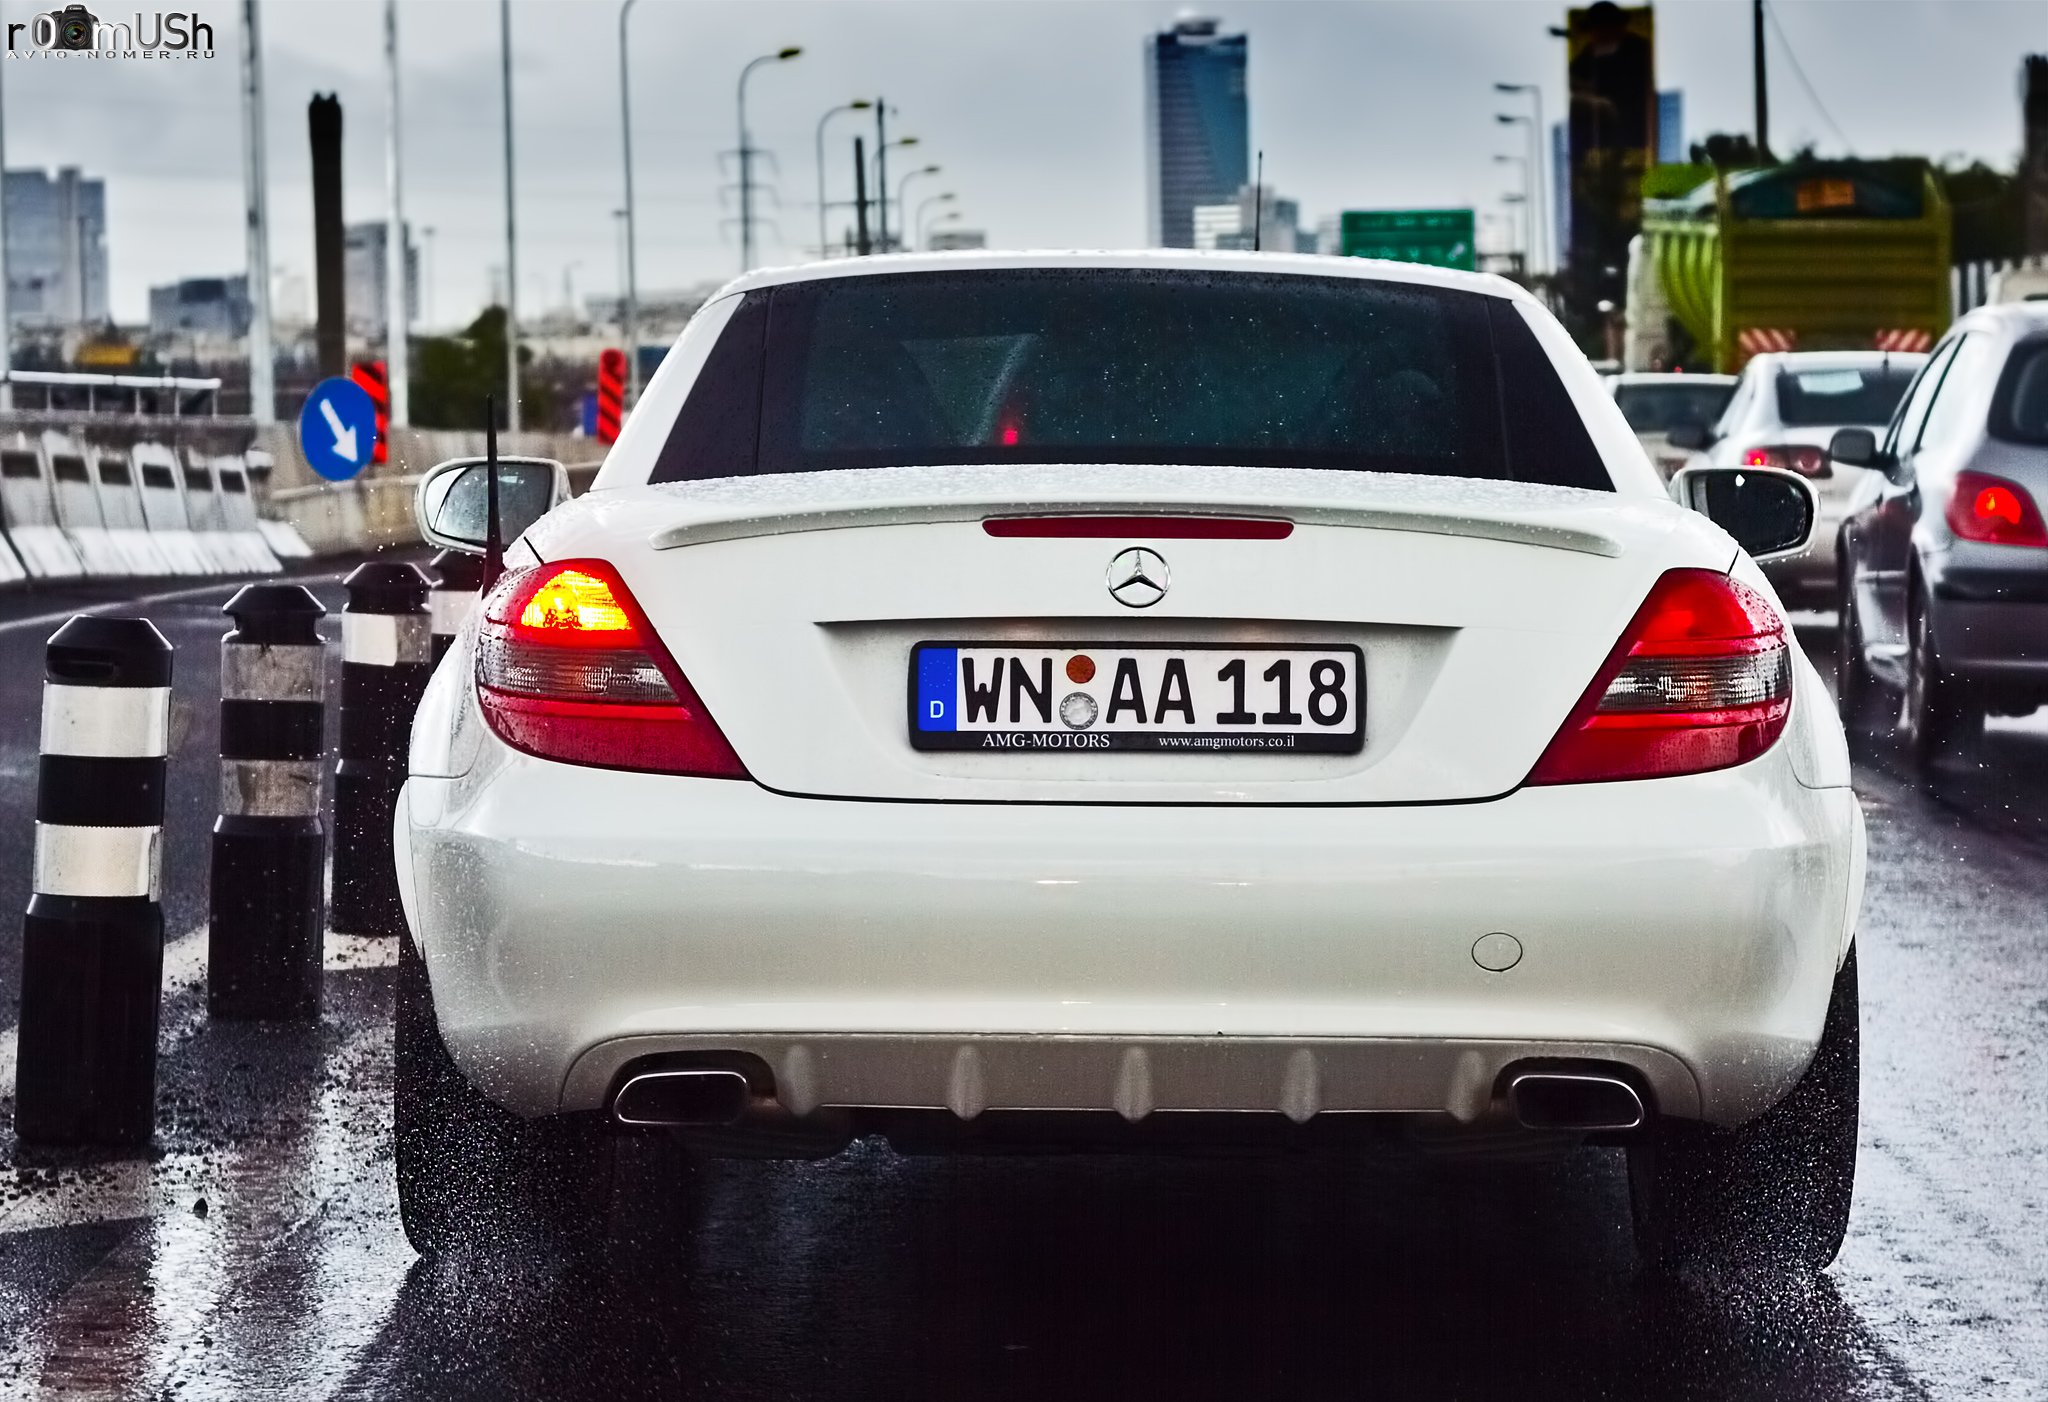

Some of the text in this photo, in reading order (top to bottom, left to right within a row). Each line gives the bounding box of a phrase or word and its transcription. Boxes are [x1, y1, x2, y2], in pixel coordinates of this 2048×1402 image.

[962, 657, 1348, 726] WN AA 118
[930, 700, 944, 719] D
[982, 733, 1295, 749] AMG-MOTORS www.amgmotors.co.il
